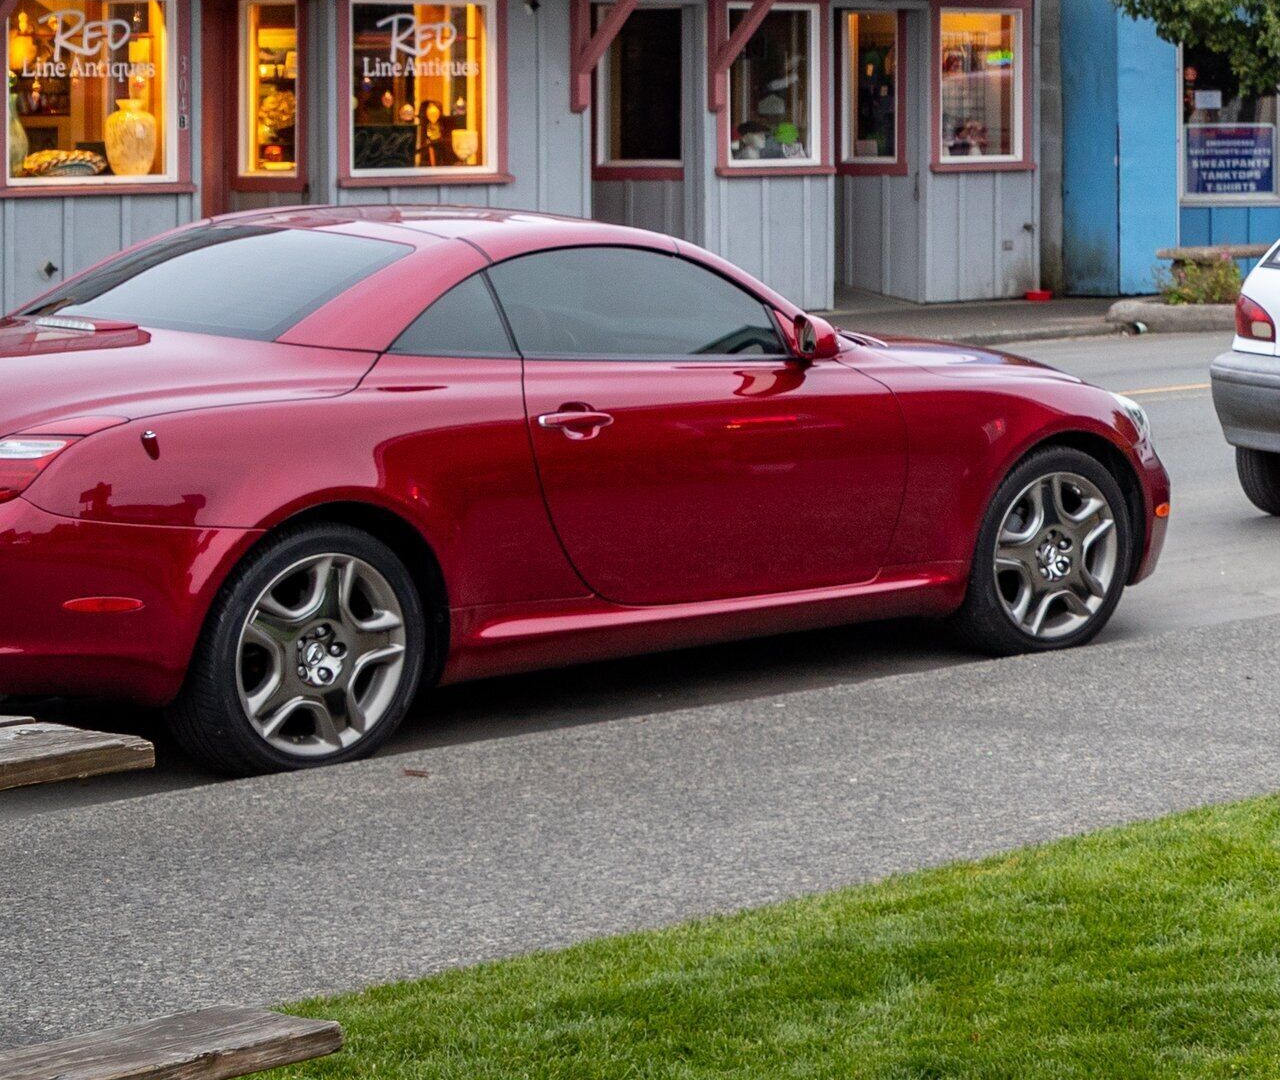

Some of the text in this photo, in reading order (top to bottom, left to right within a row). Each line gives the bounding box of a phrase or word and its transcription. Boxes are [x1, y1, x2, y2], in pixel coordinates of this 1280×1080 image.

[38, 9, 131, 62] RED
[22, 57, 156, 83] Line Antiques
[363, 57, 480, 82] Line Antiques
[1192, 159, 1270, 169] SWEATPANTS
[1201, 171, 1262, 180] TANKTOPS
[1205, 183, 1257, 192] T-SHIRTS
